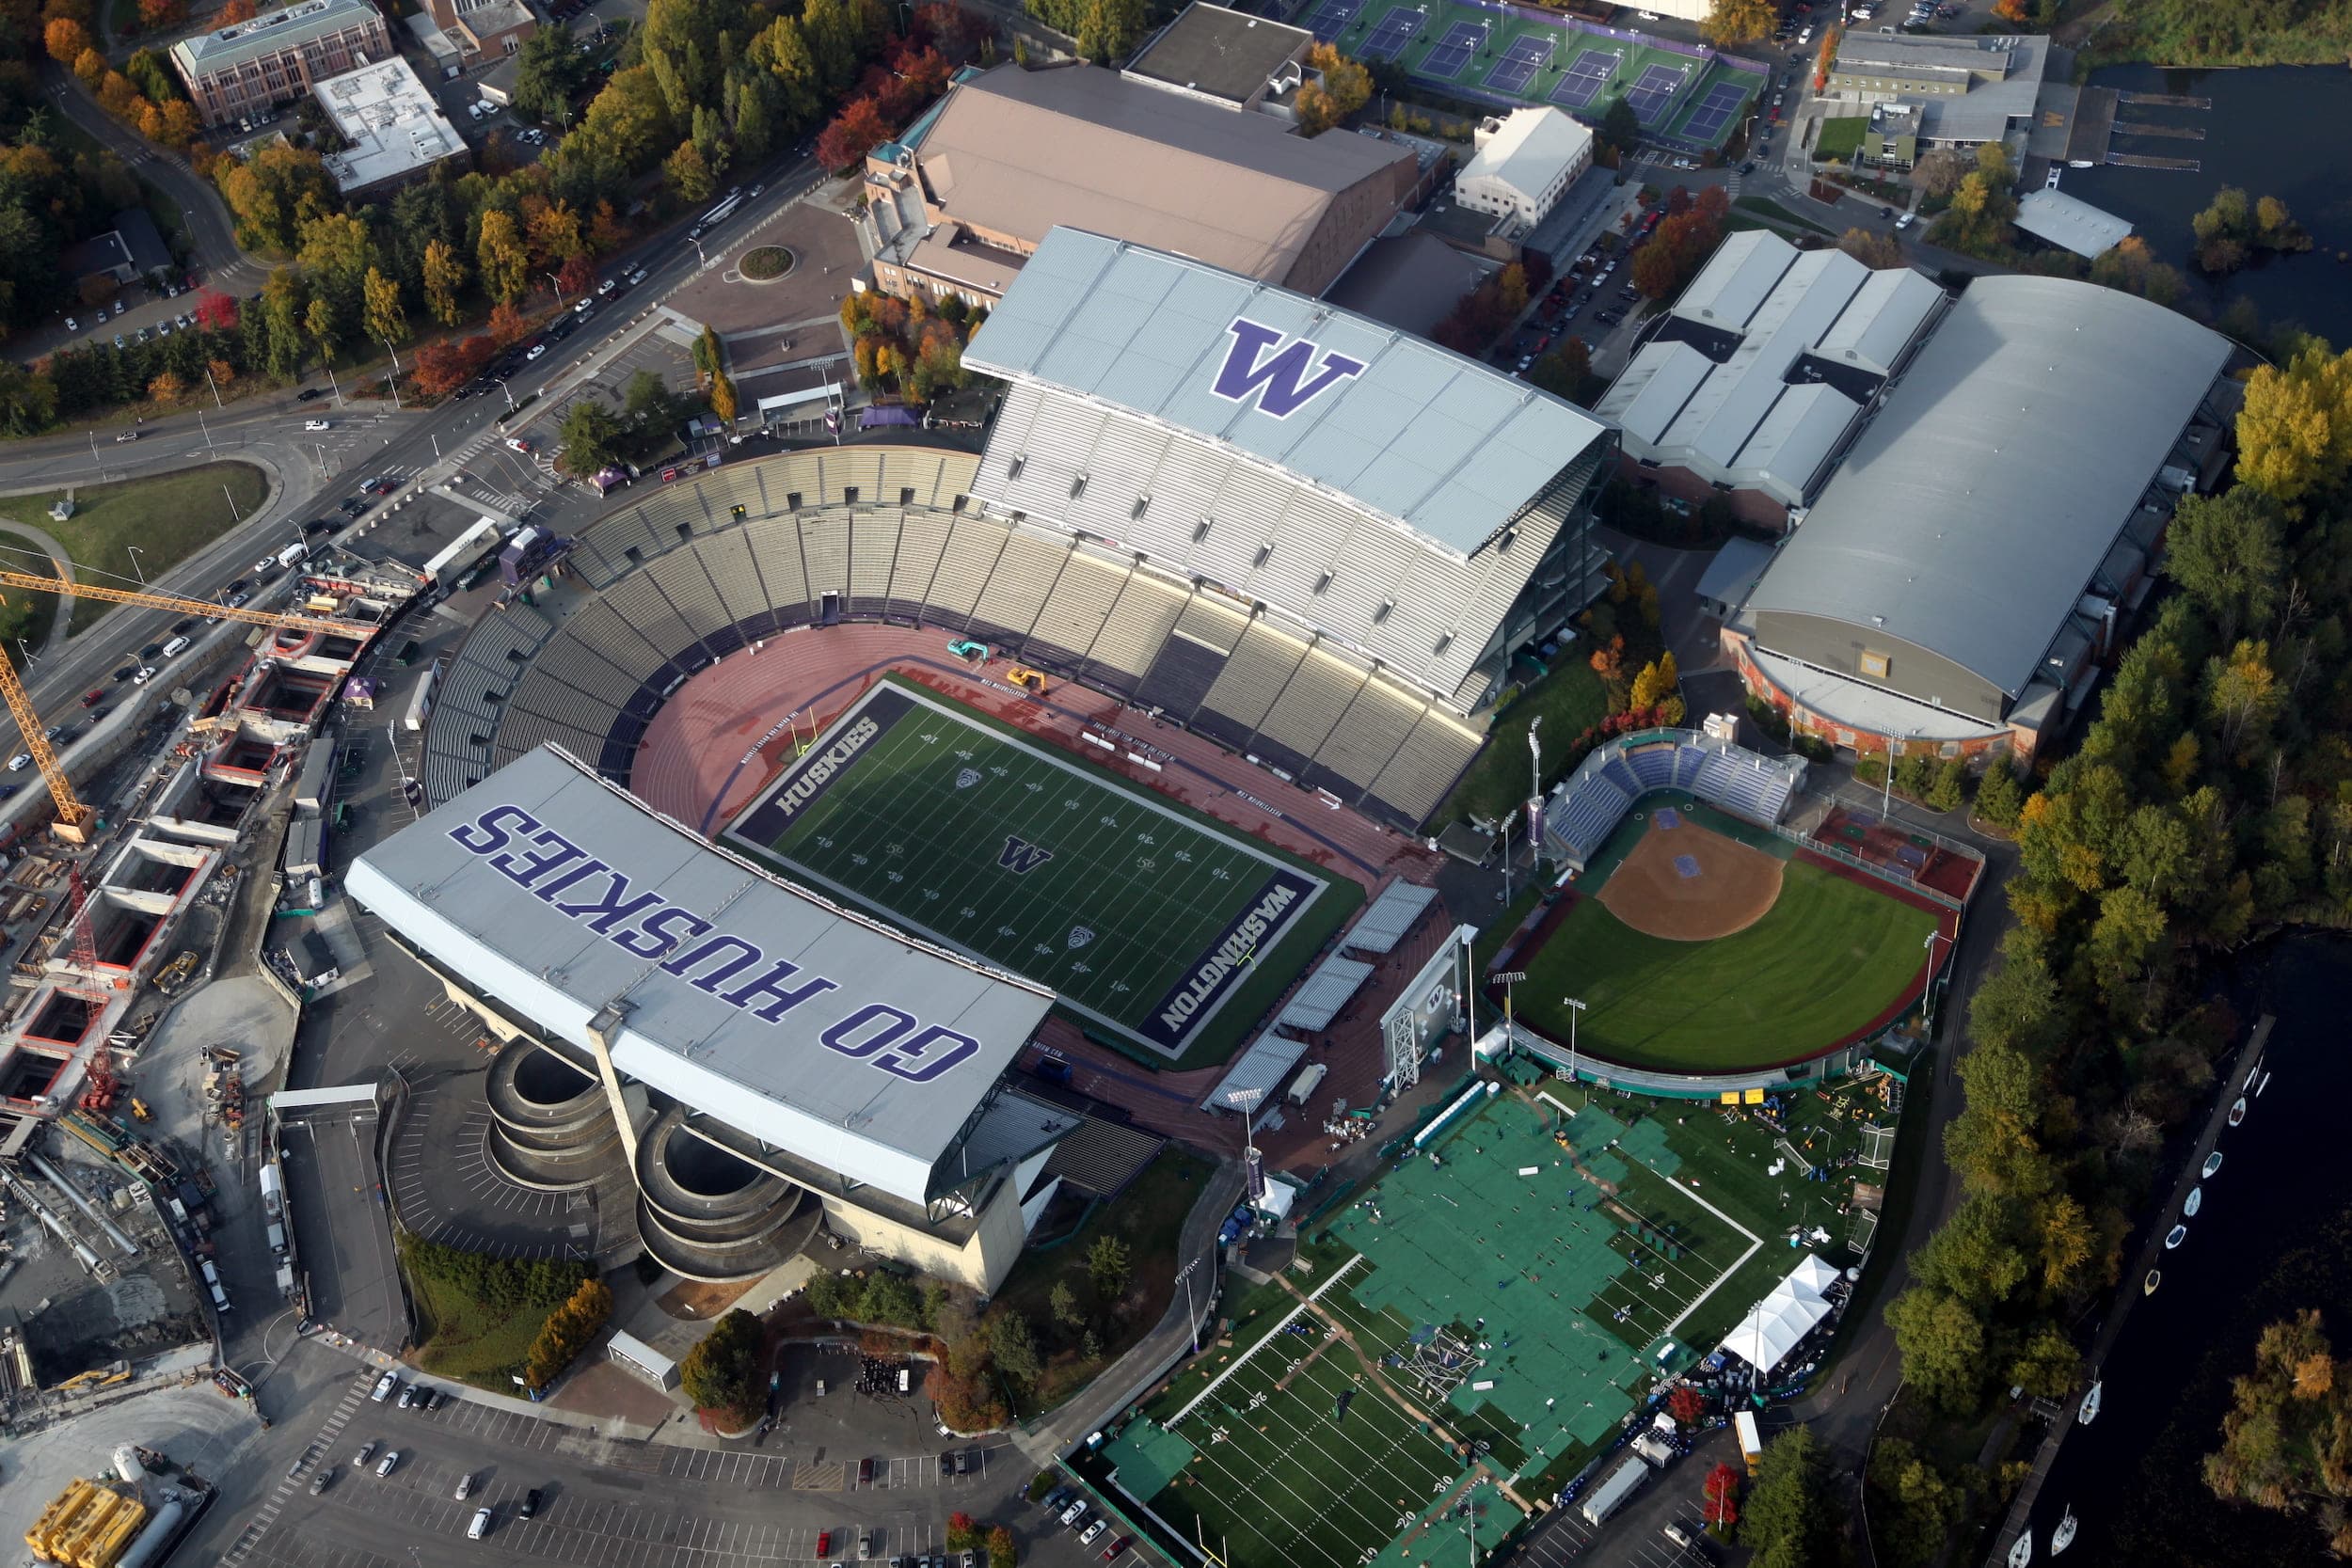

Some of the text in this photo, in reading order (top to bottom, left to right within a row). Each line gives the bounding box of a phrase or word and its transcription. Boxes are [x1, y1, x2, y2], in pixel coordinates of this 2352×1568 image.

[1209, 315, 1370, 421] W
[775, 716, 879, 816] HUSKIES
[997, 834, 1054, 875] W
[444, 804, 980, 1084] GO HUSKIES
[1160, 884, 1297, 1033] WASHINGTON
[1429, 990, 1440, 1008] W
[1648, 1275, 1665, 1291] 10
[1249, 1391, 1267, 1408] 20
[1212, 1425, 1230, 1442] 10
[1435, 1475, 1454, 1493] 30
[1398, 1511, 1416, 1529] 20
[1360, 1546, 1378, 1566] 10
